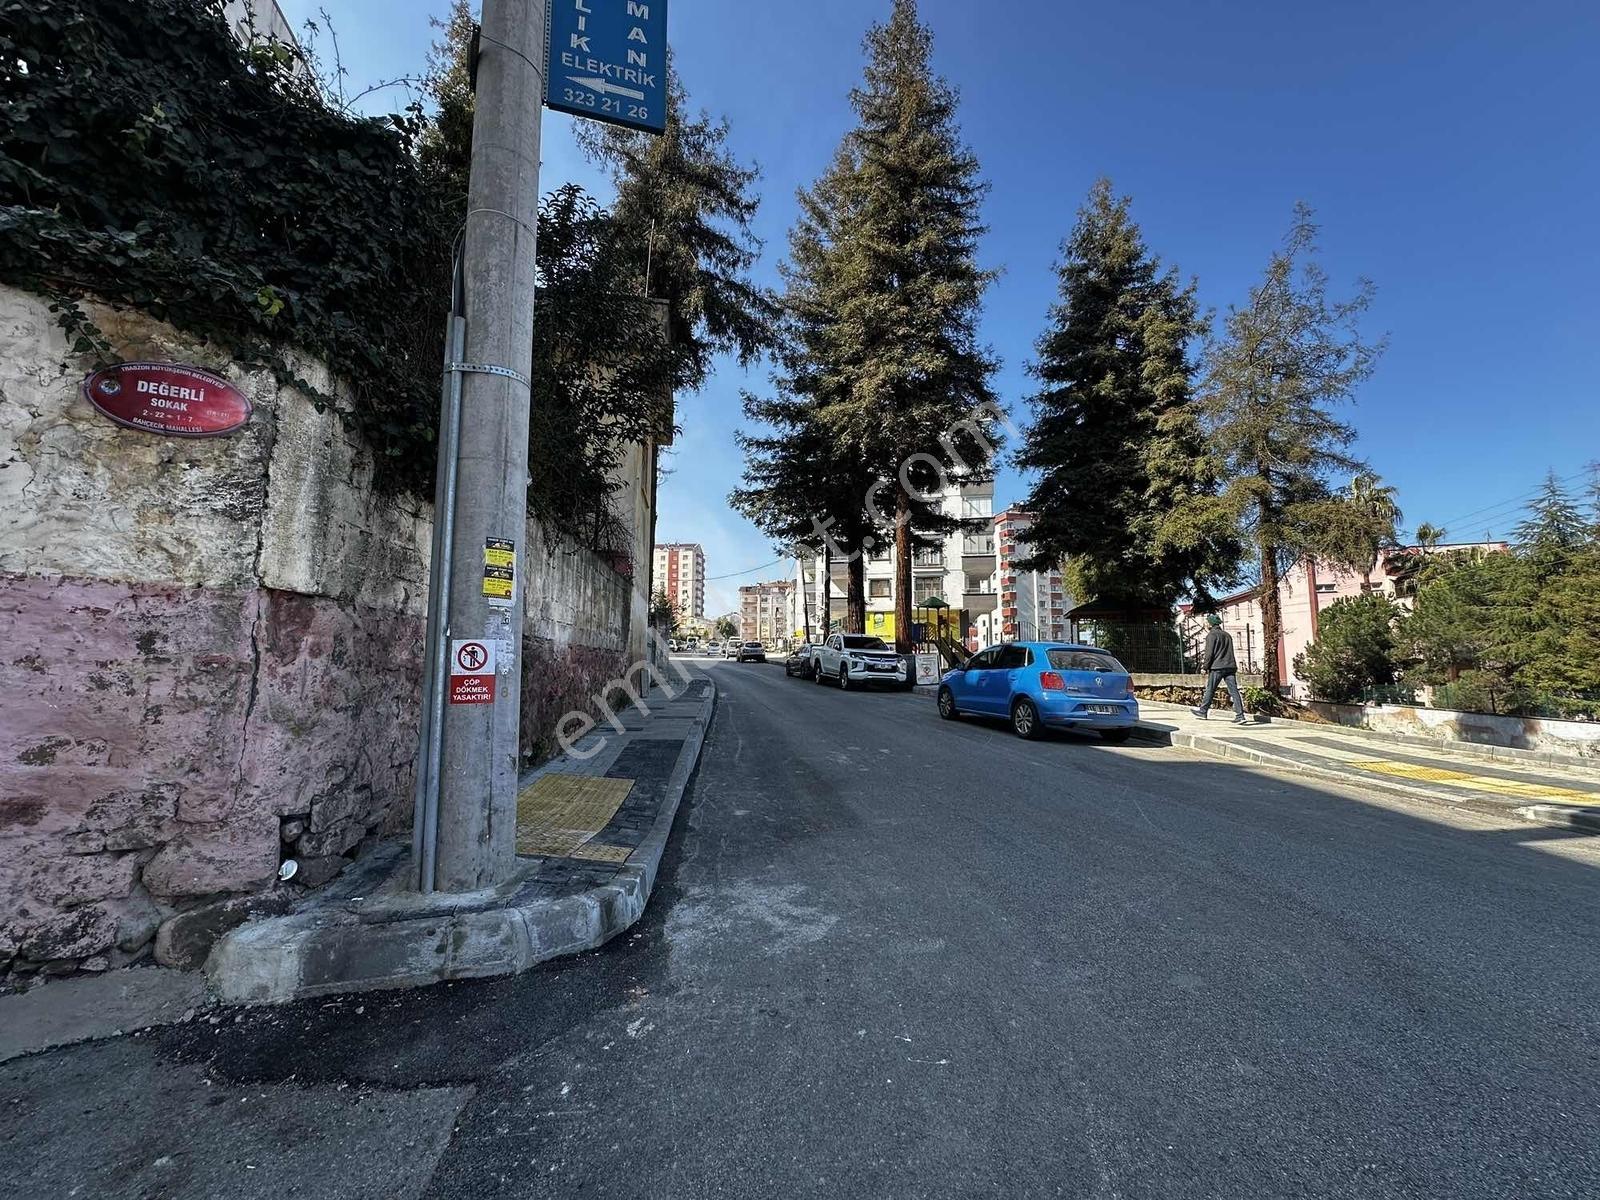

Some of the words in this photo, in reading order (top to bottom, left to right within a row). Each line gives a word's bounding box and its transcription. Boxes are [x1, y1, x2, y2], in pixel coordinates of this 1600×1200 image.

[561, 52, 656, 88] ELEKTRİK
[563, 88, 596, 107] 323
[601, 98, 620, 113] 21
[627, 104, 648, 120] 26
[121, 365, 151, 373] TRABZON
[192, 371, 227, 390] BELEDİYESİ
[137, 380, 205, 402] DEĞERLİ
[150, 398, 188, 412] SOKAK
[133, 417, 165, 429] BAHÇECİK
[165, 423, 203, 433] MAHALLESİ
[463, 678, 480, 686] ÇÖP
